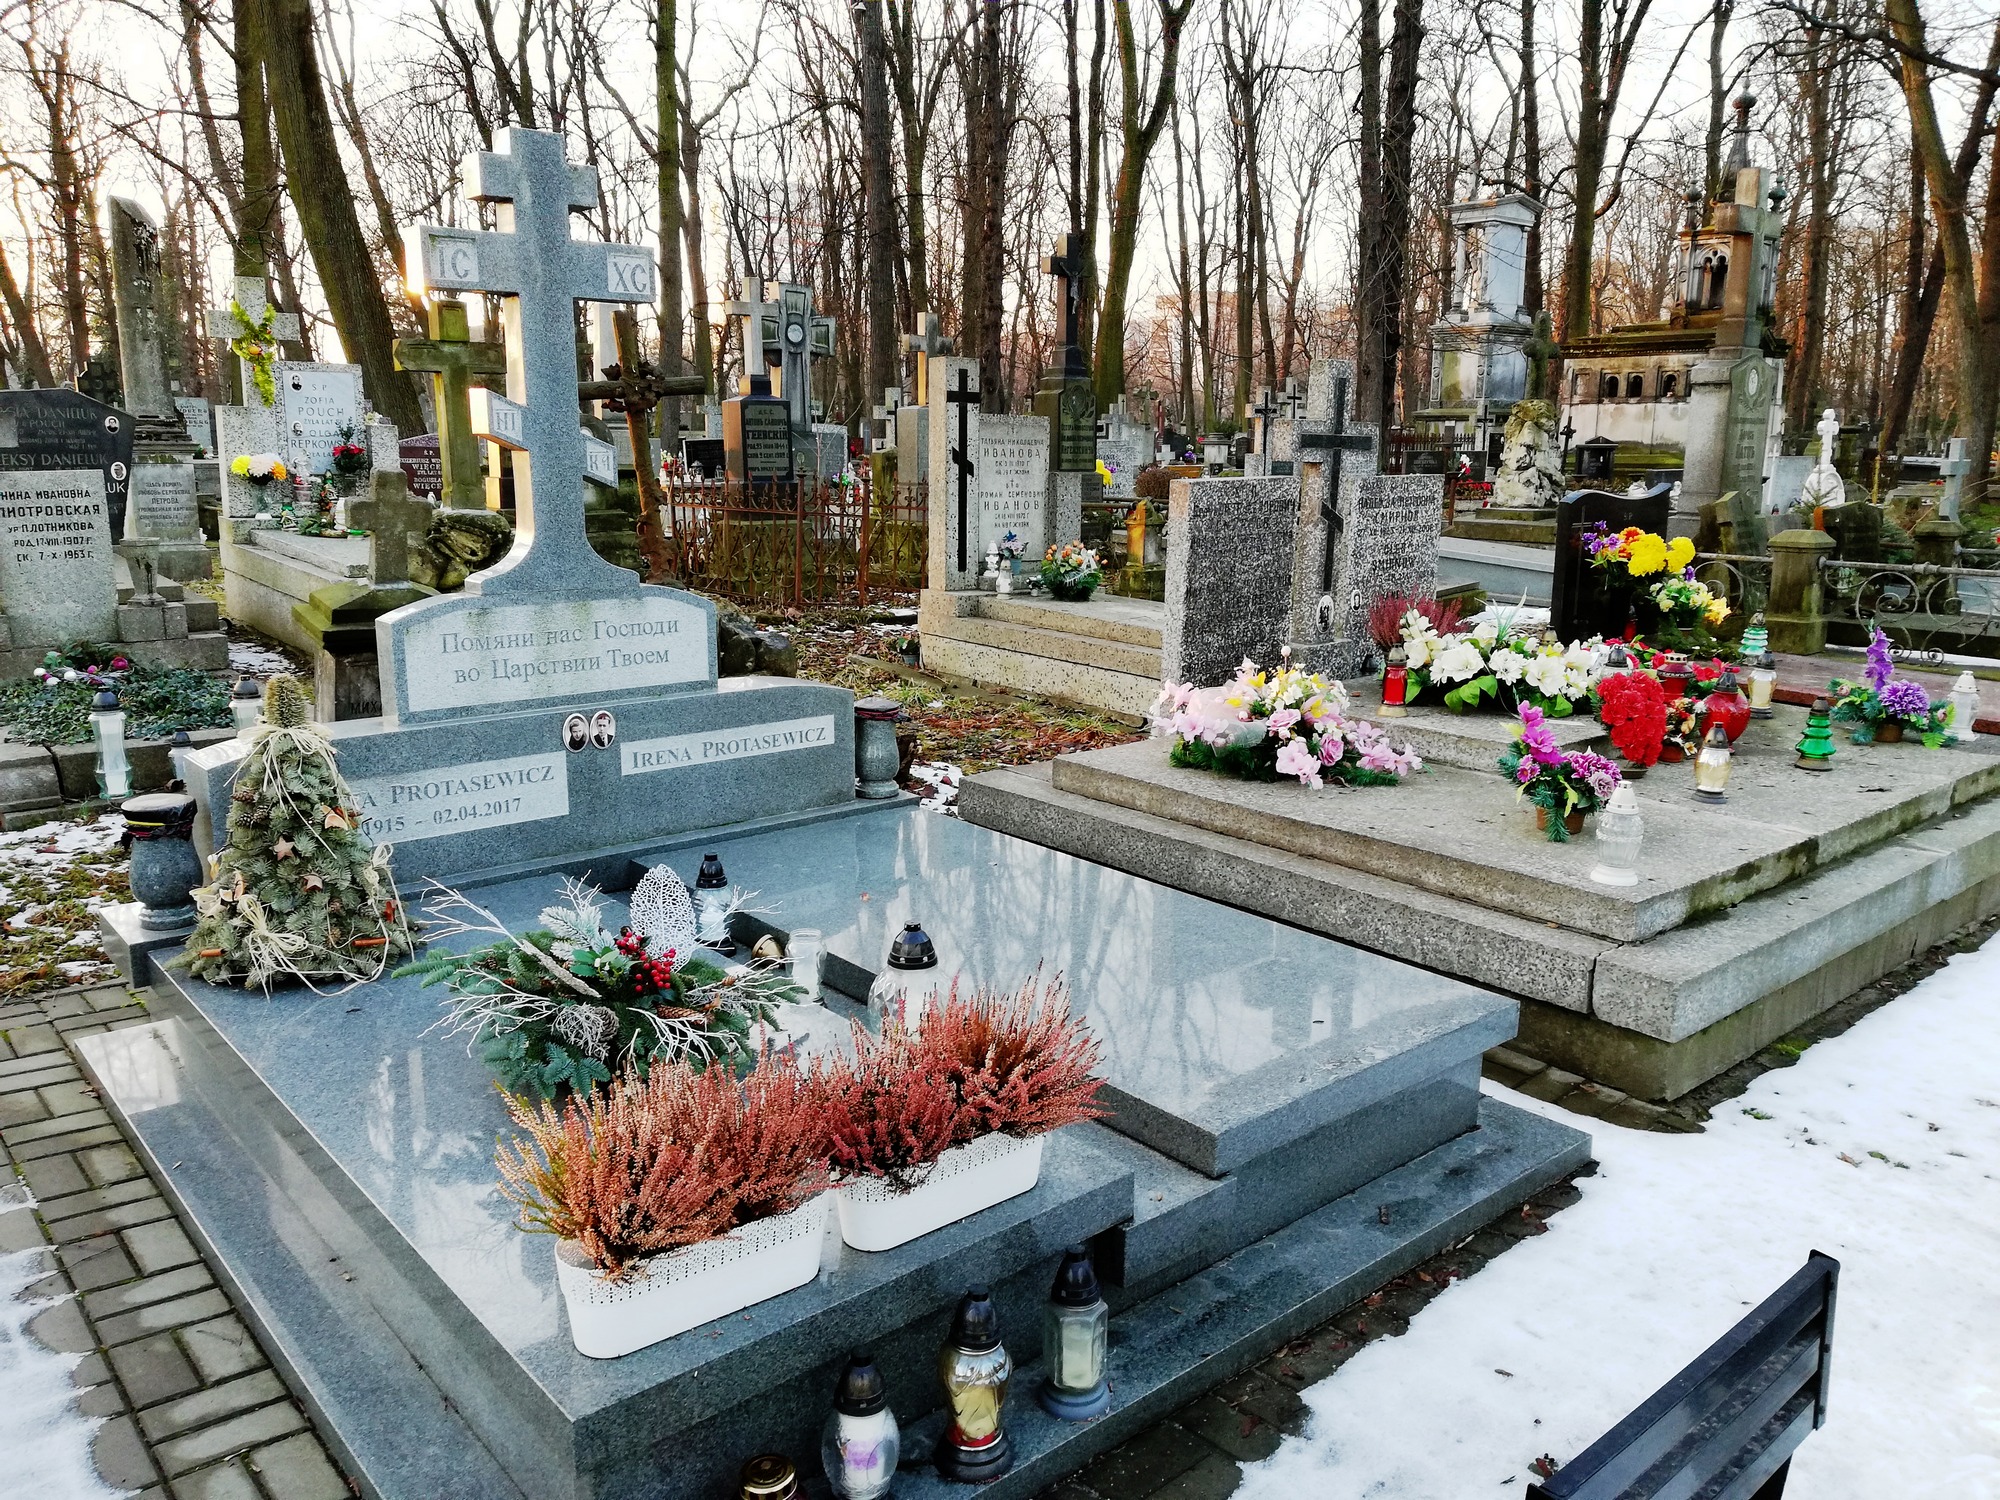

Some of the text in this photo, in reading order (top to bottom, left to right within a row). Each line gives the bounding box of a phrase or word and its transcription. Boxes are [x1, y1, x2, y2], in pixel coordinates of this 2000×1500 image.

[304, 396, 335, 404] ZOFIA
[298, 407, 344, 416] POUCH
[984, 448, 1040, 458] ИВАНОВА
[41, 453, 109, 466] DANIELUK
[103, 483, 126, 493] UK
[36, 489, 91, 500] ИВАНОВНА
[984, 500, 1039, 510] ИВАНОВ
[21, 522, 94, 533] ПЛОТНИКОВА
[440, 619, 679, 654] Помяни нас Господи
[454, 648, 670, 684] во Царствии Твоем
[433, 797, 521, 825] 02.04.2017
